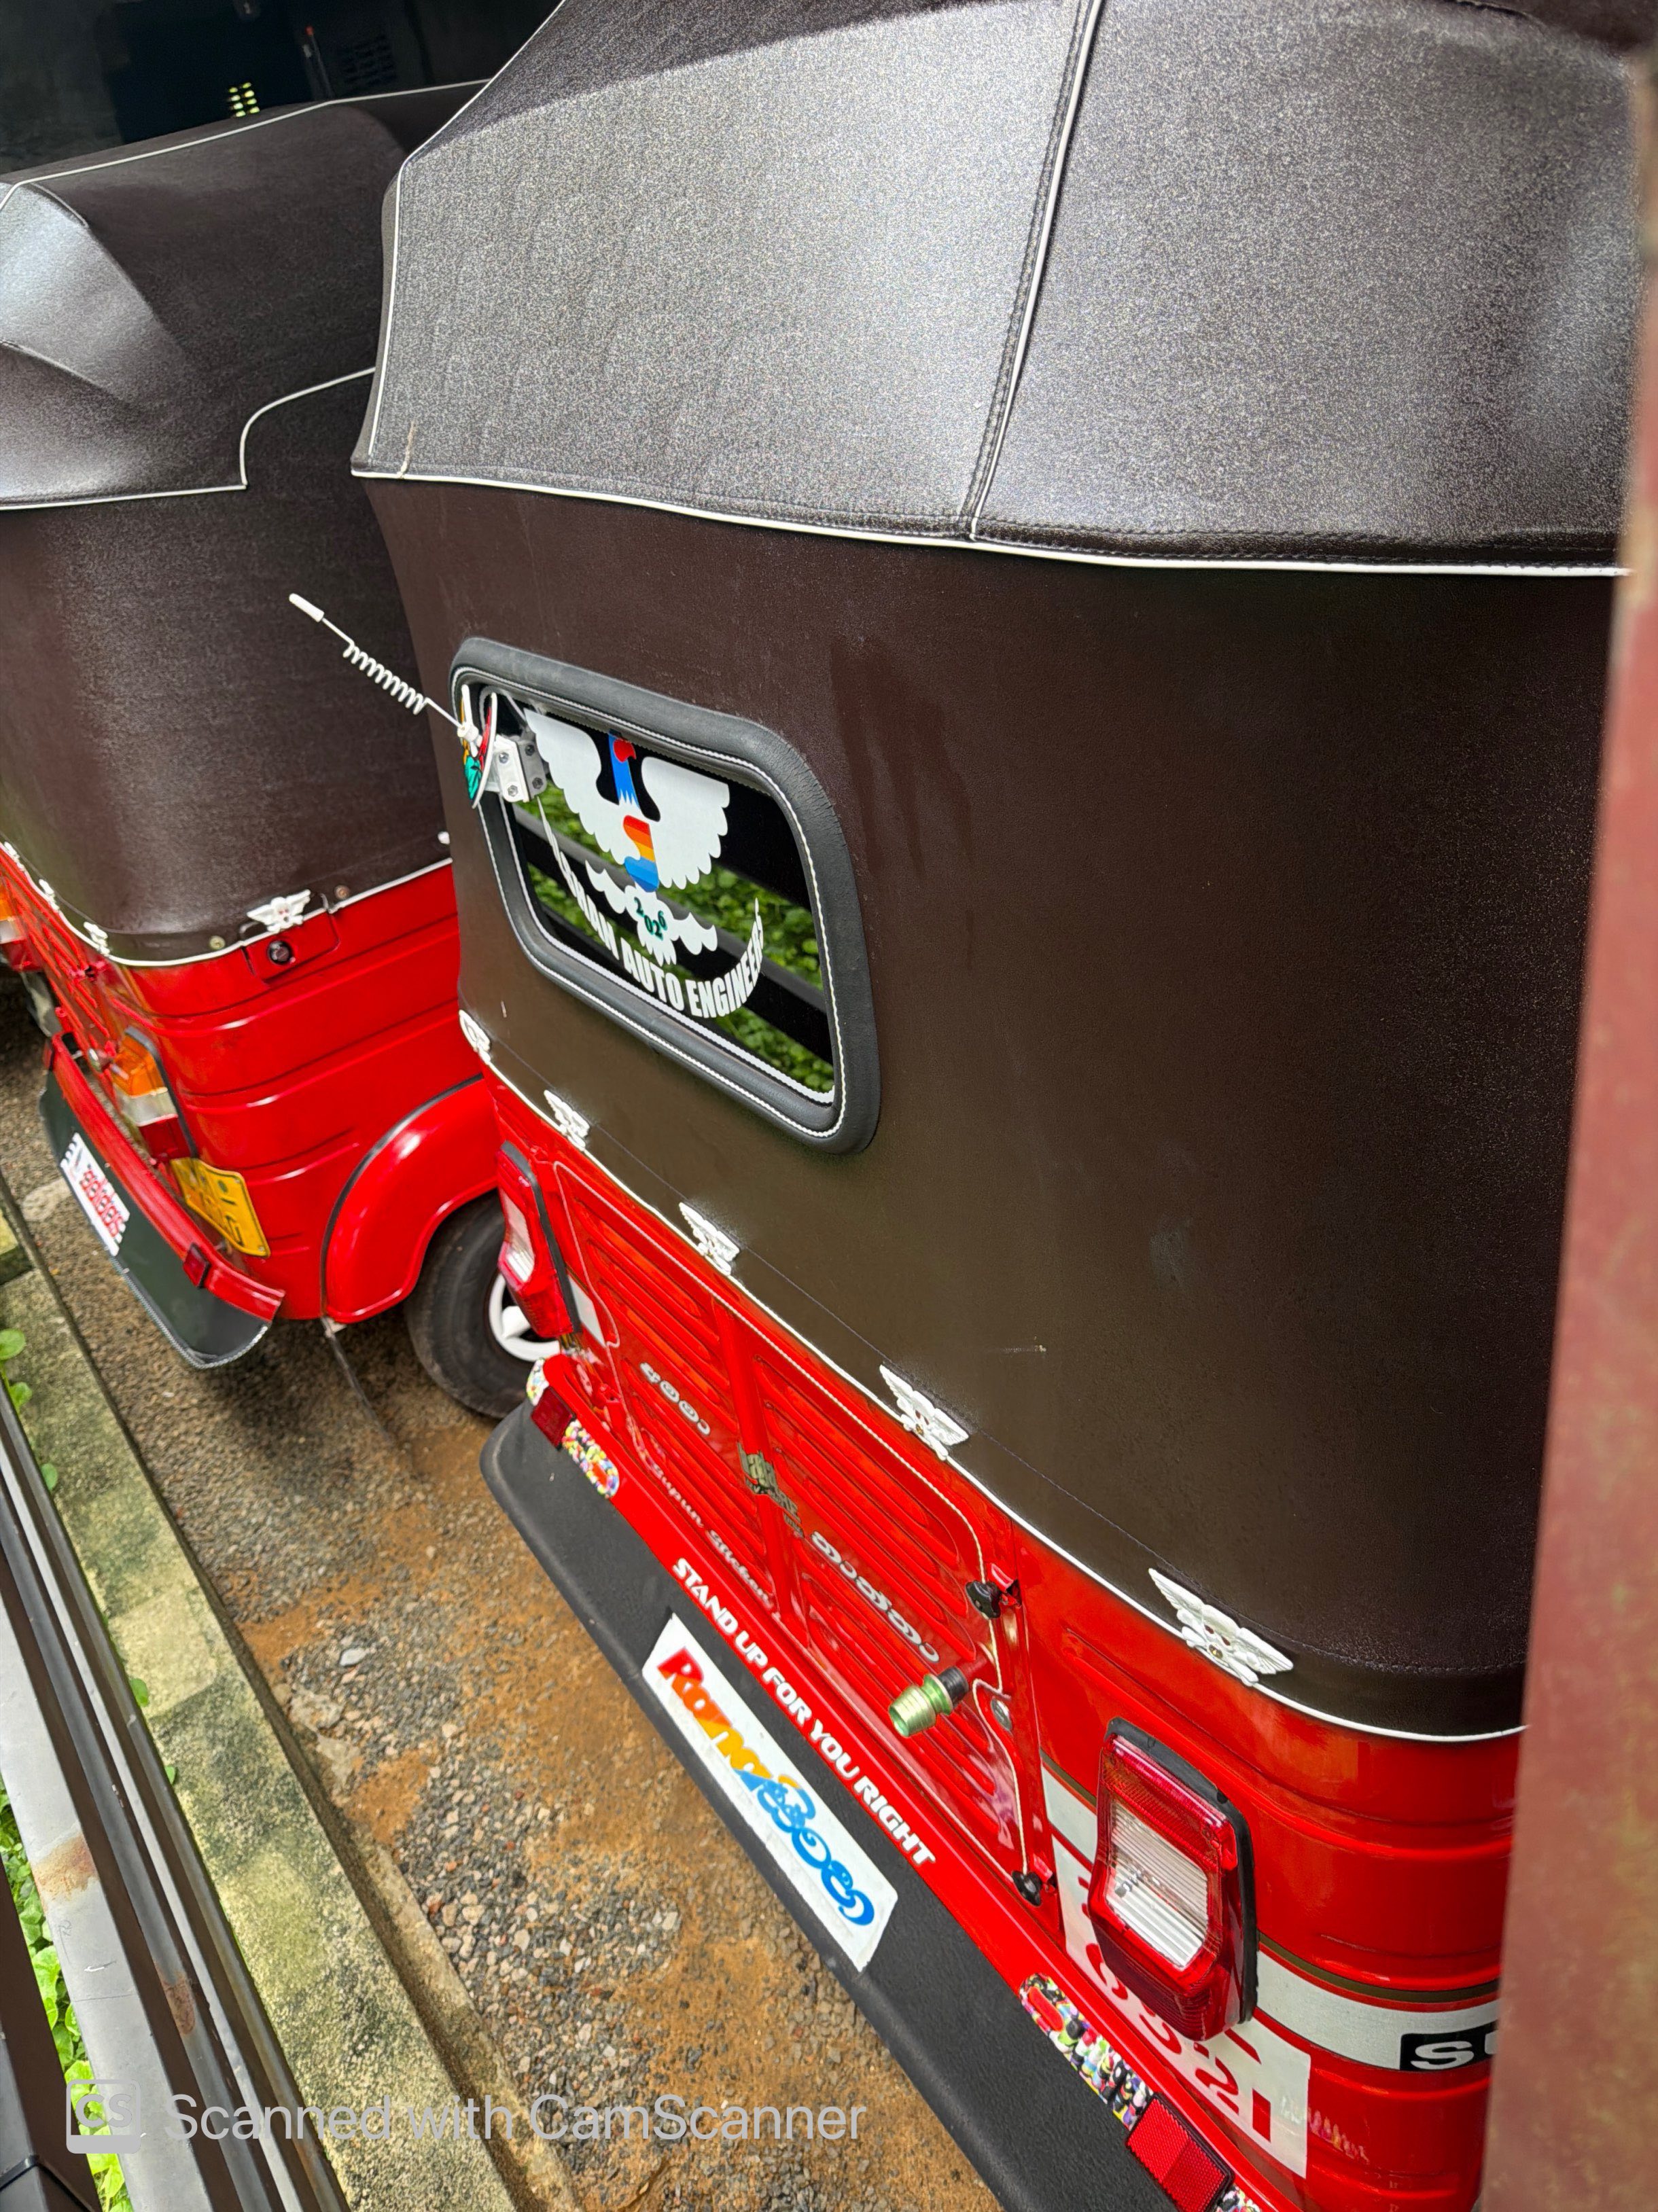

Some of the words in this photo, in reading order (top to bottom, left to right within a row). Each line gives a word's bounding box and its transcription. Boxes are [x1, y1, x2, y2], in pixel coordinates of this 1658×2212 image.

[620, 936, 685, 1012] AUTO
[685, 897, 764, 1018] ENGINEERS
[634, 897, 667, 940] 2026
[811, 1530, 940, 1664] තාත්තා
[672, 1557, 739, 1636] STAND
[735, 1630, 769, 1668] UP
[762, 1666, 812, 1727] FOR
[809, 1719, 860, 1780] YOU
[853, 1775, 936, 1866] RIGHT
